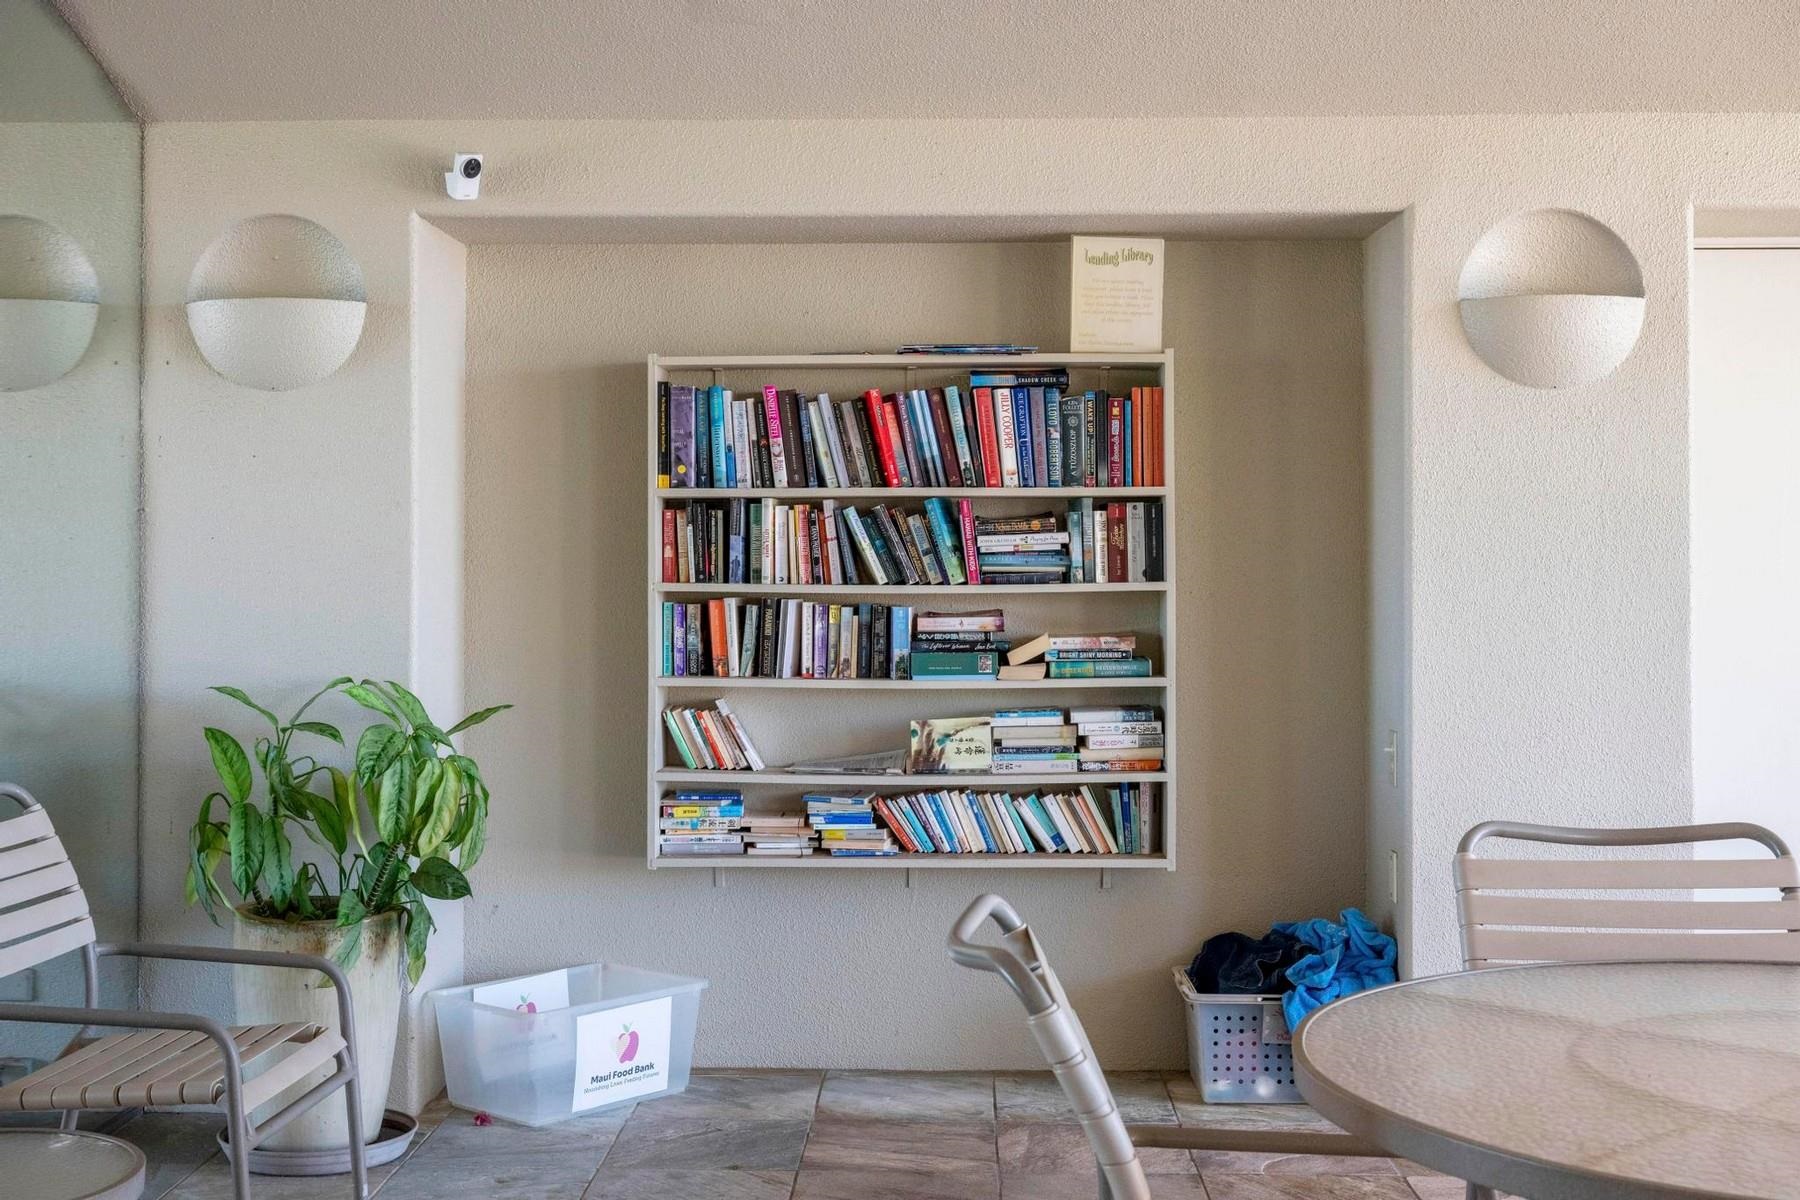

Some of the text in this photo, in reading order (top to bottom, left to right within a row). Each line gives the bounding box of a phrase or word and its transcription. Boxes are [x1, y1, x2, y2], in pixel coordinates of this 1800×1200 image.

[1084, 248, 1154, 267] Lending Library
[766, 389, 776, 418] DANIELLE
[1000, 392, 1014, 449] JILLY COOPER
[1018, 406, 1026, 436] GRAFTON
[713, 424, 721, 468] Bittersweet
[1048, 404, 1060, 480] LLOYD ROBERTSON
[591, 1062, 654, 1084] Maui Food Bank
